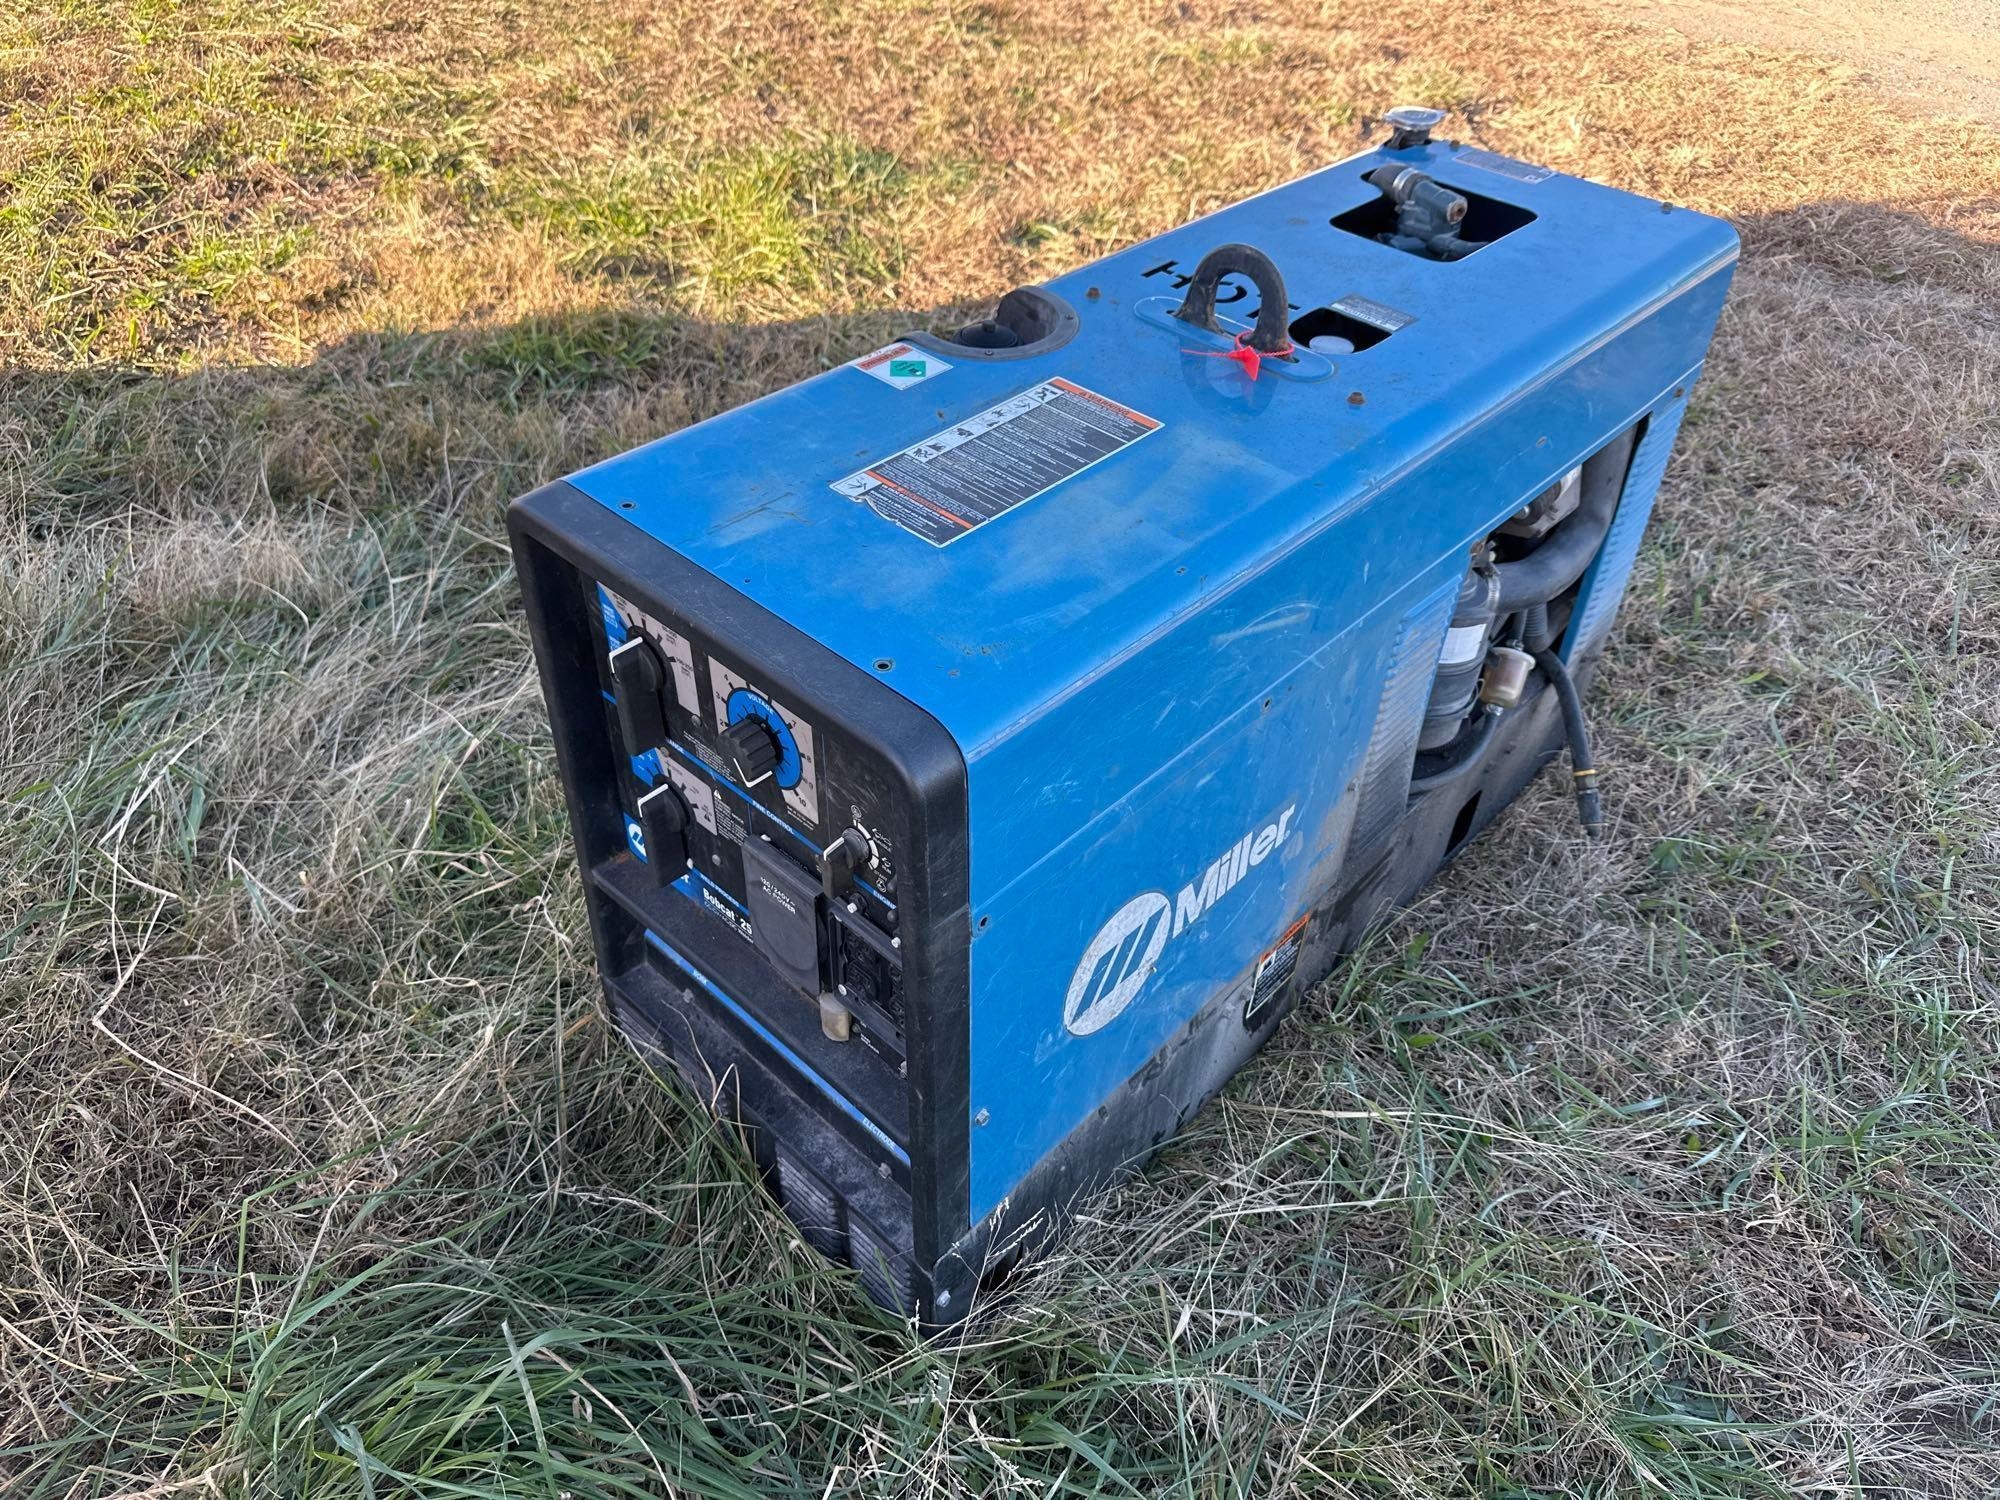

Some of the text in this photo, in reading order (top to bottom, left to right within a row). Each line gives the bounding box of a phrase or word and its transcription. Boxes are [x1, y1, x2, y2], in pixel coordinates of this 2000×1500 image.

[1087, 393, 1130, 416] WARNING
[747, 693, 776, 716] VOLTAGE
[798, 797, 807, 808] 10
[766, 811, 795, 835] CONTROL
[1172, 802, 1296, 939] Miller
[703, 887, 753, 936] Bobcat 25
[772, 893, 796, 916] POWER
[862, 1117, 896, 1151] ELECTRODE
